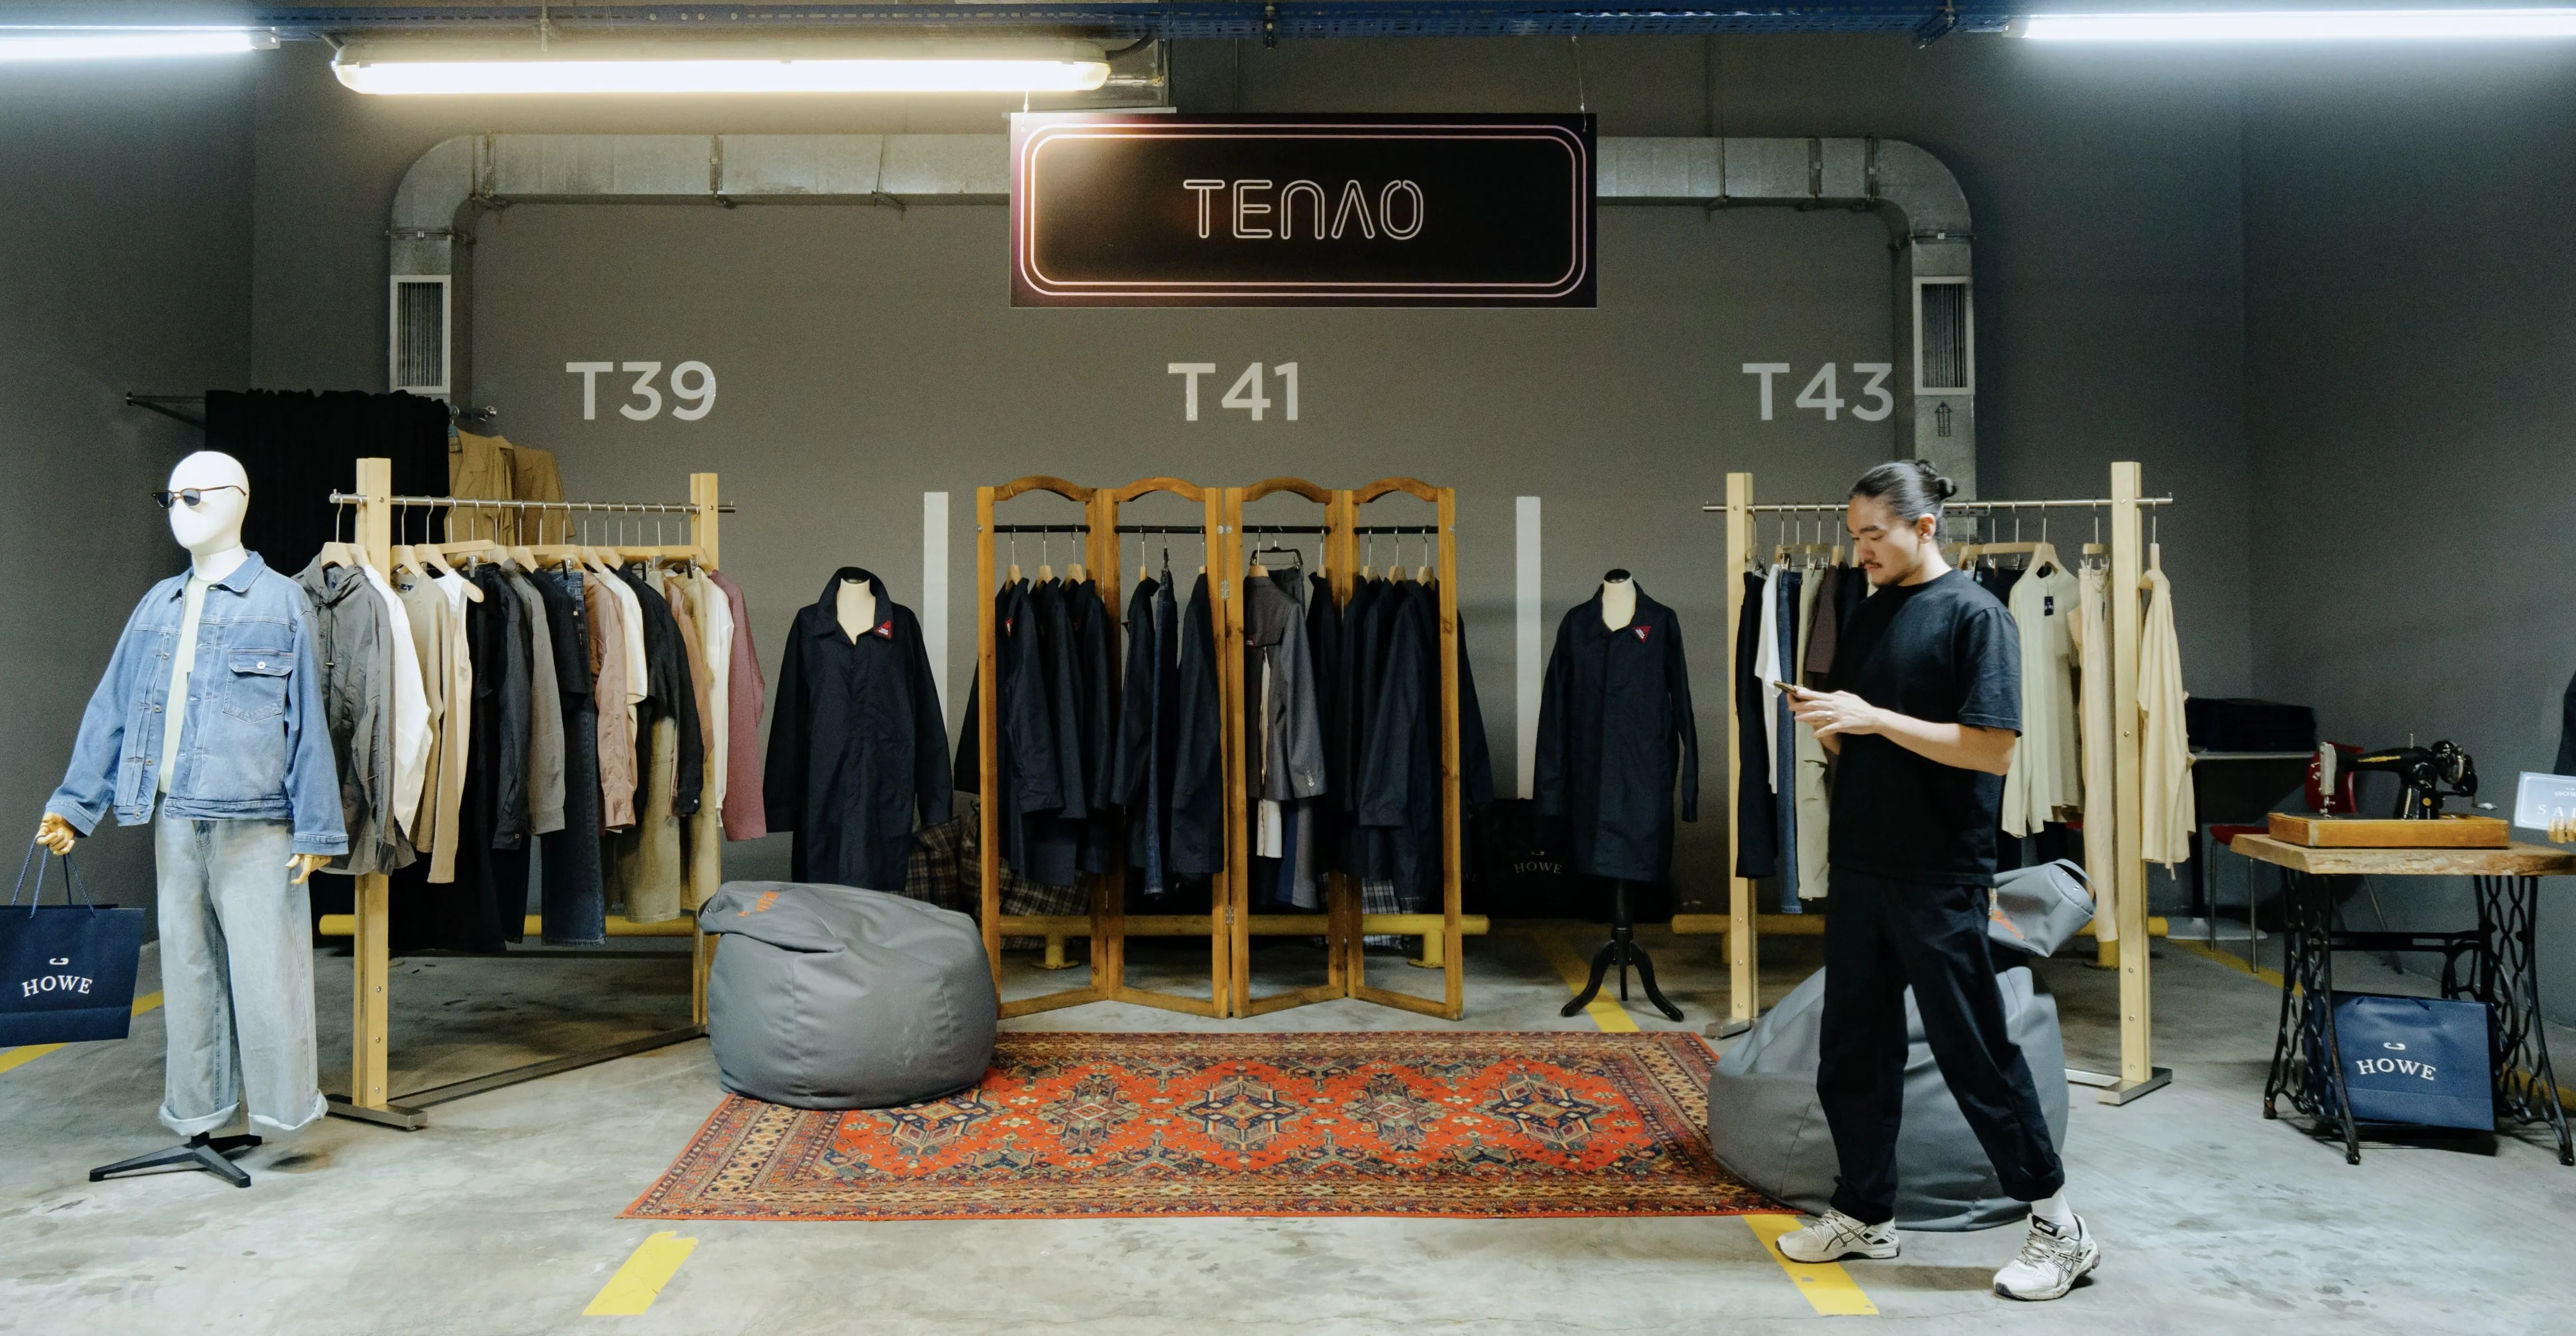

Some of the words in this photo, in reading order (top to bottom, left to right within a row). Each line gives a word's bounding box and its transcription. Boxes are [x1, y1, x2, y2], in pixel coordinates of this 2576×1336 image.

[566, 360, 716, 421] T39
[1168, 362, 1298, 421] T41
[1742, 362, 1894, 422] T43
[1513, 861, 1563, 875] HOWE
[22, 975, 93, 997] HOWE
[2356, 1058, 2436, 1081] HOWE
